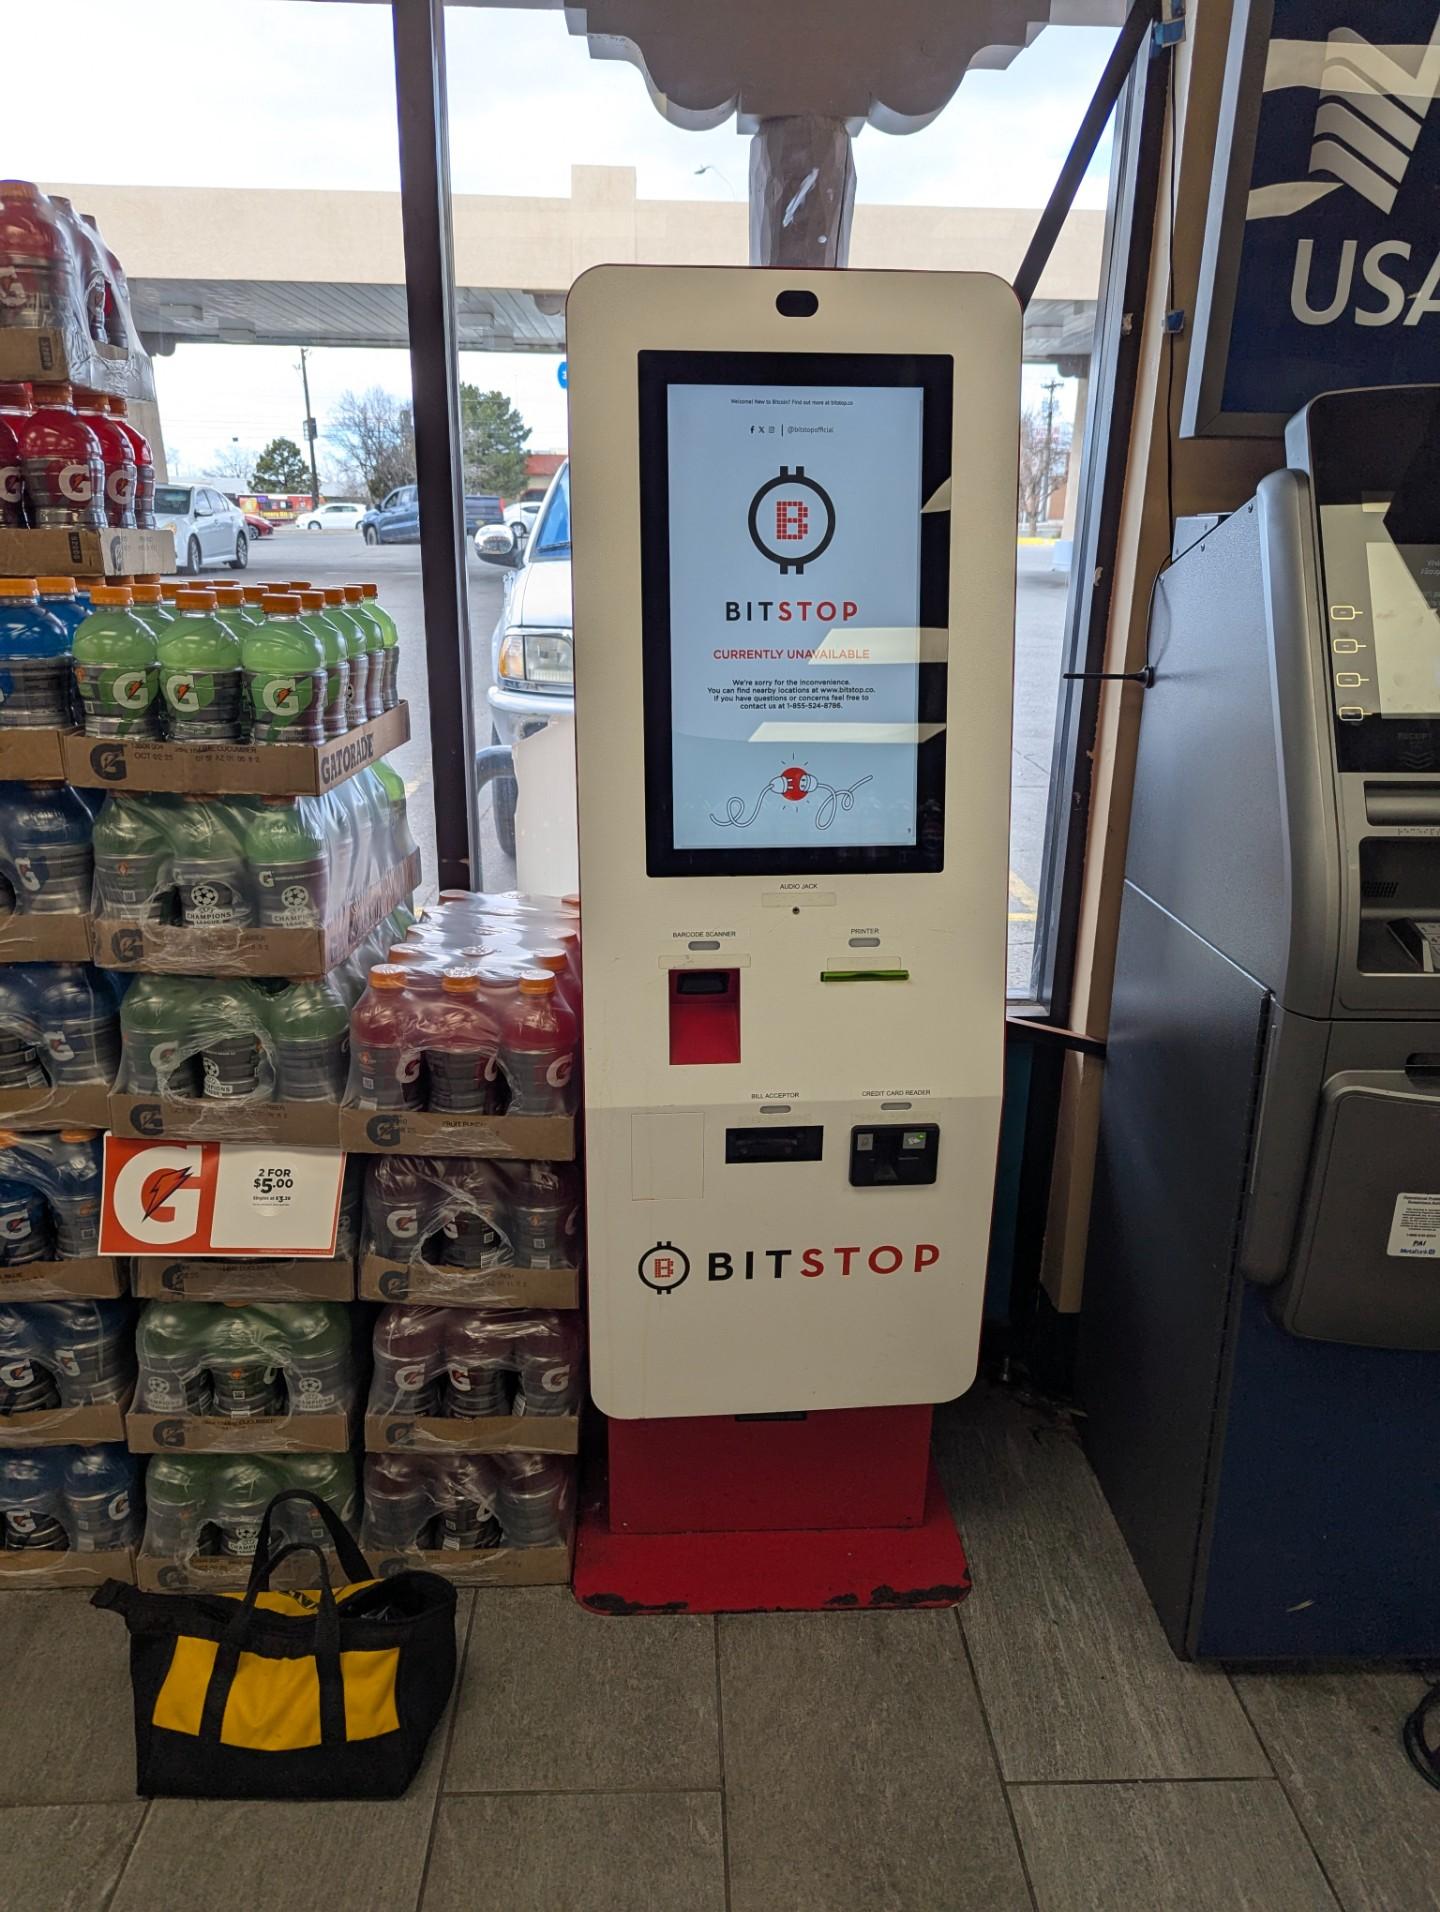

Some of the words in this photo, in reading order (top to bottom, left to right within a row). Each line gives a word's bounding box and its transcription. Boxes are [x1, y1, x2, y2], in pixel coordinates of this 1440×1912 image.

[58, 464, 92, 501] G
[726, 601, 858, 622] BITSTOP
[713, 649, 784, 660] CURRENTLY
[787, 649, 870, 660] UNAVAILABLE
[113, 671, 149, 710] G
[166, 675, 200, 713] G
[263, 679, 299, 716] G
[752, 687, 776, 695] nearby
[753, 695, 787, 703] questions
[90, 743, 127, 781] G
[320, 733, 375, 785] GATORADE
[14, 856, 41, 892] G
[259, 870, 275, 888] G
[186, 911, 232, 920] CHAMPIONS
[111, 929, 144, 962] G
[43, 1031, 75, 1061] G
[129, 1103, 165, 1136] G
[253, 1178, 294, 1194] $5.00
[258, 1168, 265, 1177] 2
[267, 1168, 291, 1177] FOR
[112, 1144, 203, 1245] G
[0, 1208, 32, 1240] G
[386, 1208, 418, 1239] G
[708, 1244, 940, 1281] BITSTOP
[0, 1358, 35, 1388] G
[55, 1349, 81, 1377] G
[394, 1362, 426, 1391] G
[448, 1362, 472, 1391] G
[541, 1364, 570, 1393] G
[152, 1418, 185, 1447] G
[6, 1508, 37, 1533] G
[108, 1490, 131, 1521] G
